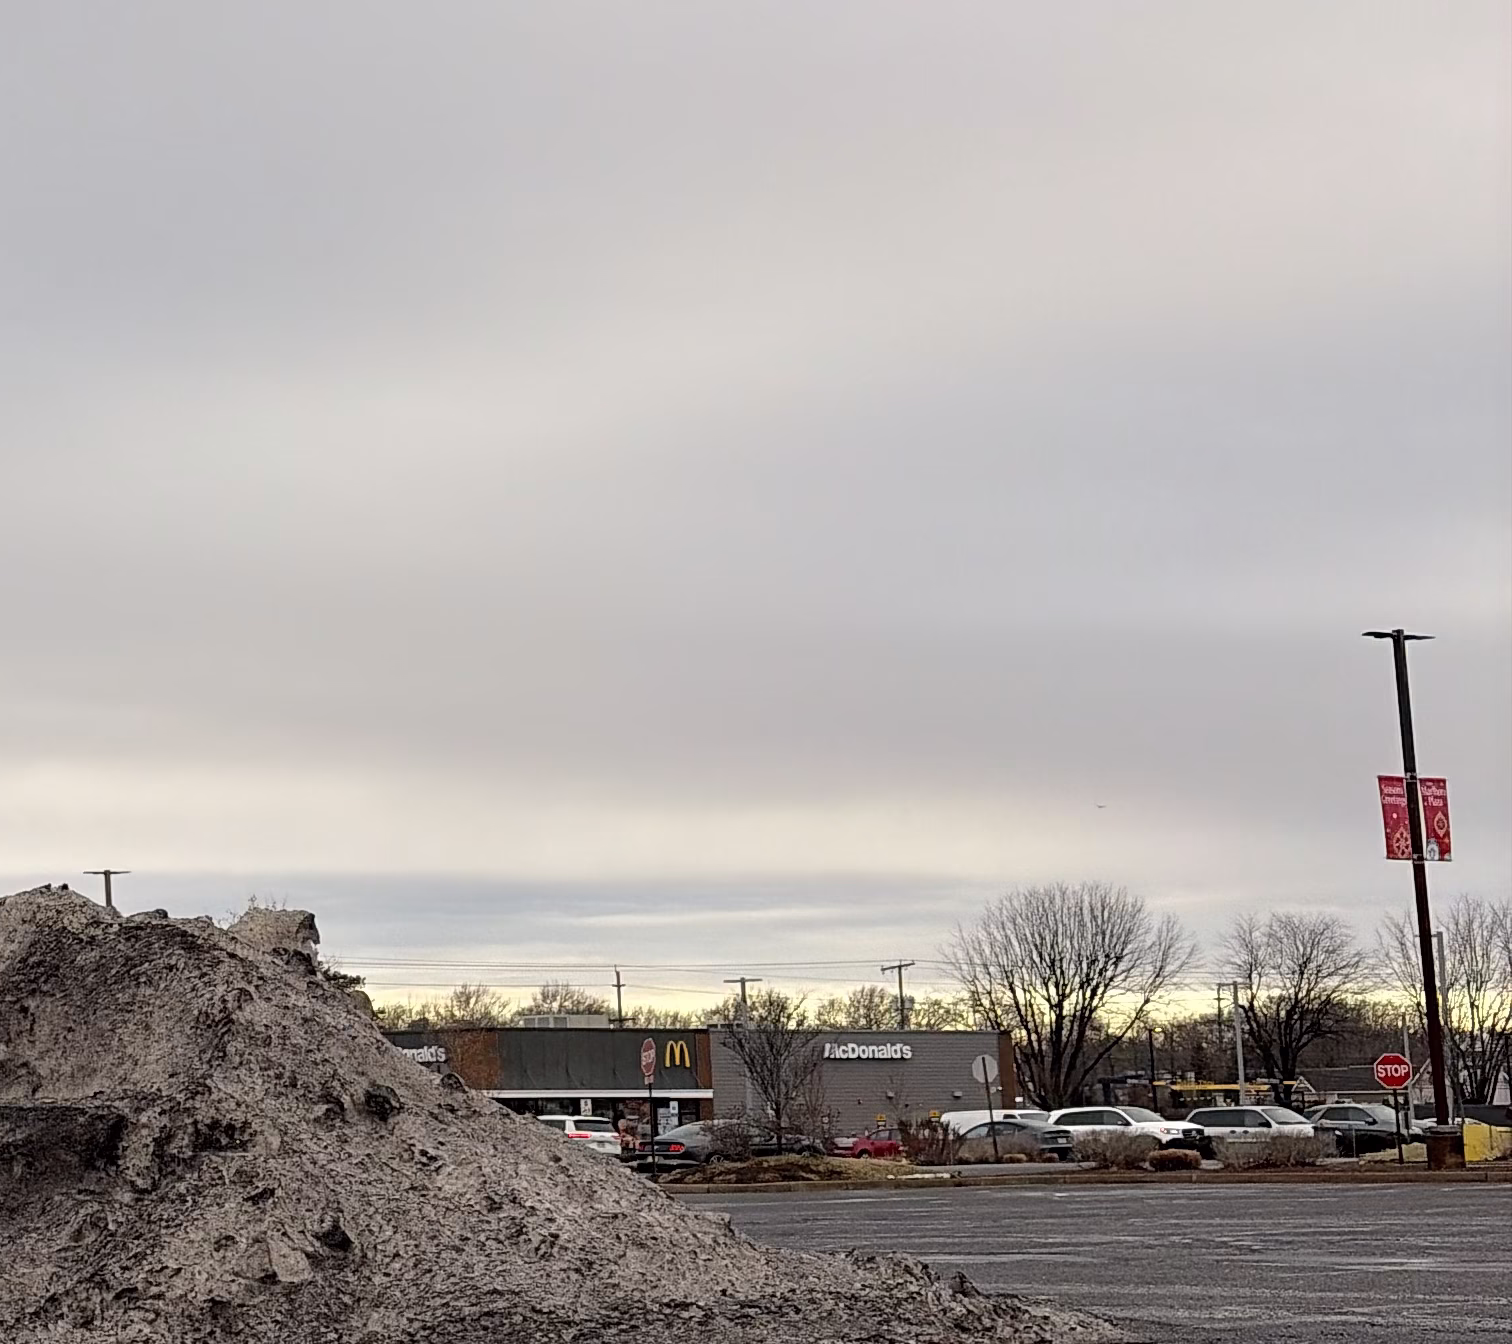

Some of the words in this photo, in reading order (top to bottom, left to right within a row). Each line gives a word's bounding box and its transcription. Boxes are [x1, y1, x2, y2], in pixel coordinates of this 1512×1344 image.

[397, 1045, 446, 1063] onald's
[823, 1042, 913, 1059] McDonald's
[1377, 1064, 1408, 1077] STOP
